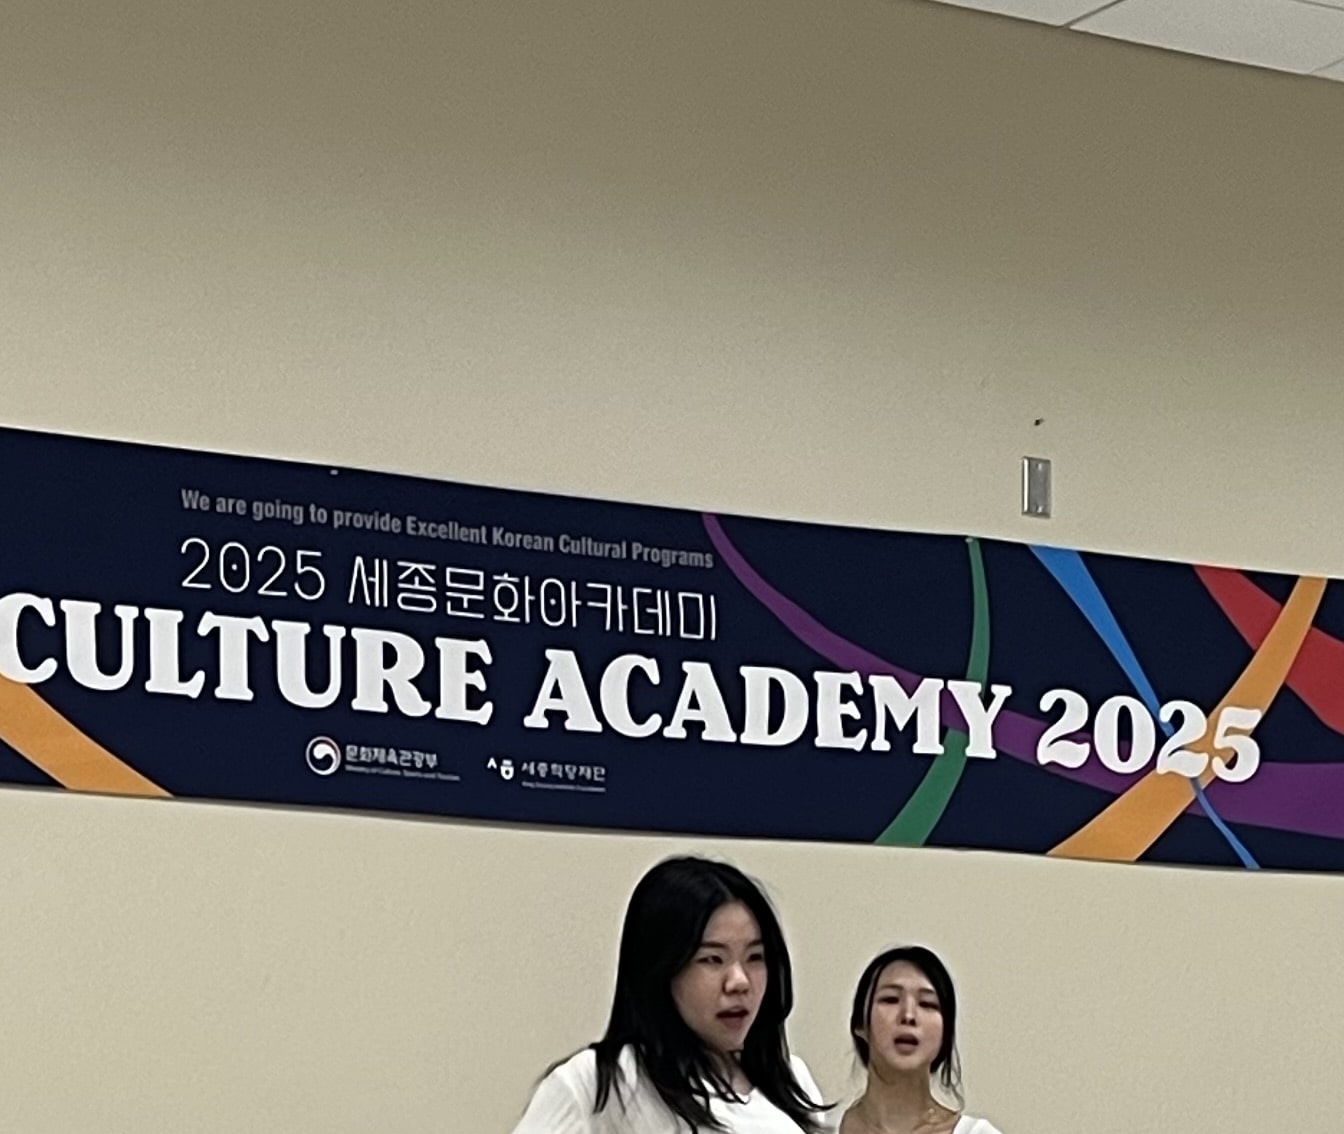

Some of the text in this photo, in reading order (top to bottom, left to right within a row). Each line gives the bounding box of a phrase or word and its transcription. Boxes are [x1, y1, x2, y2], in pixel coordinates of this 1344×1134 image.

[181, 488, 714, 568] We are going to provide Excellent Korean Cultural Programs
[181, 537, 718, 641] 2025 세종문화아카데미
[523, 648, 1013, 759] ACADEMY
[1036, 689, 1265, 783] 2025
